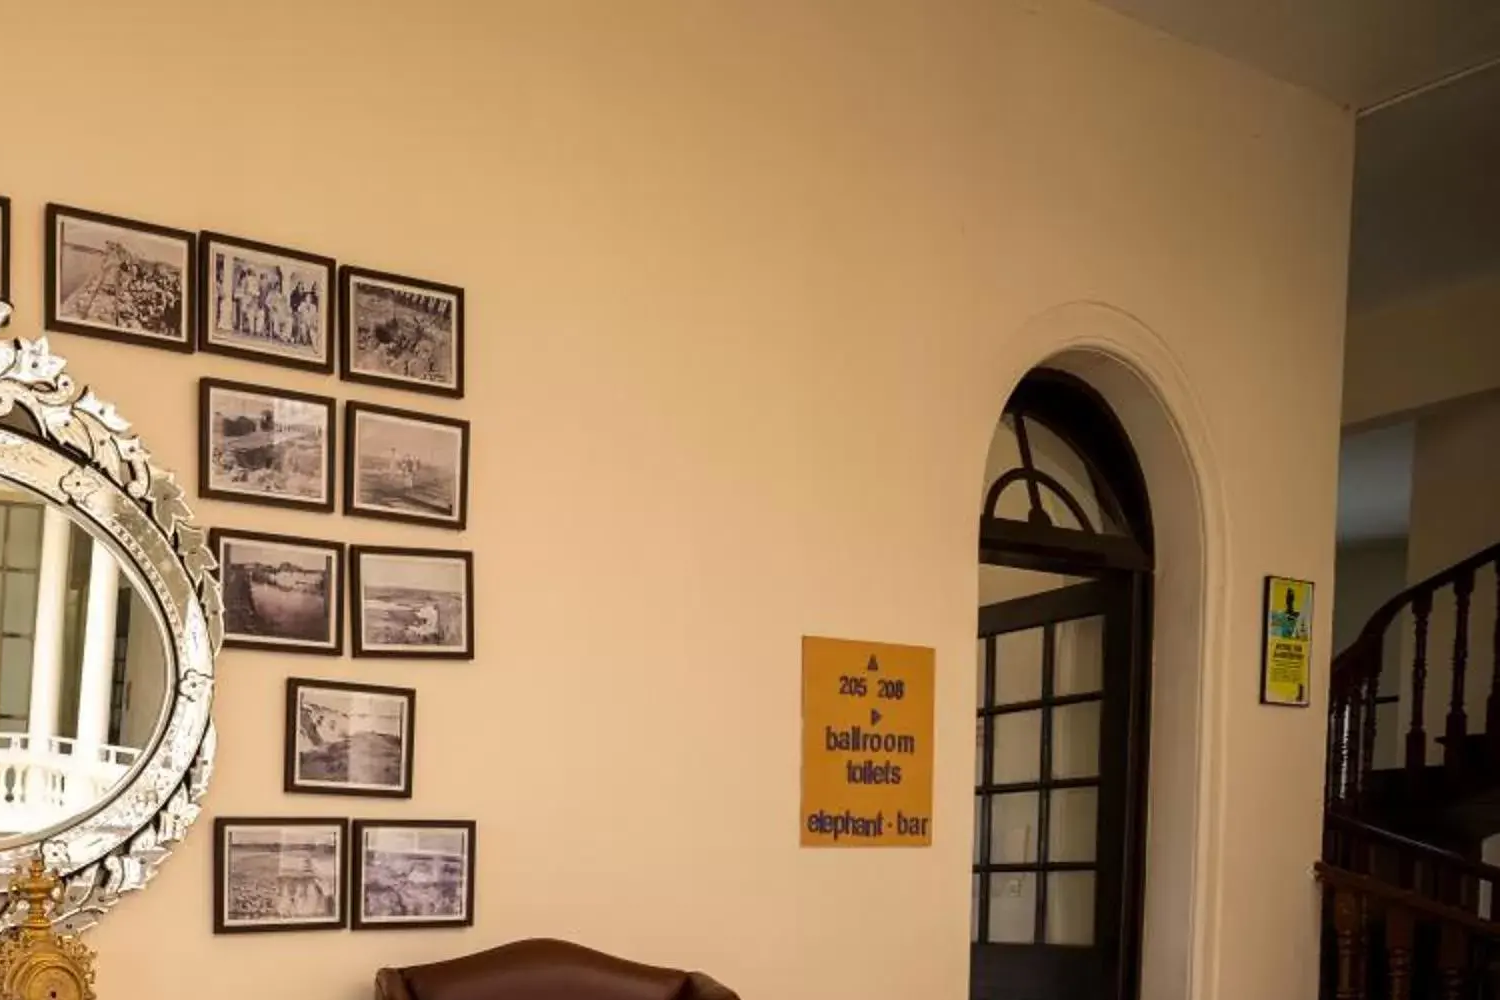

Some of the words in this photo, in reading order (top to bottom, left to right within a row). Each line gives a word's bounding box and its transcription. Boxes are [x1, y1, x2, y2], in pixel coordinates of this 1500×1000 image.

[838, 675, 867, 697] 205
[825, 725, 915, 755] ballroom
[846, 759, 902, 785] toilets
[807, 809, 884, 841] elephant
[897, 809, 930, 837] bar
